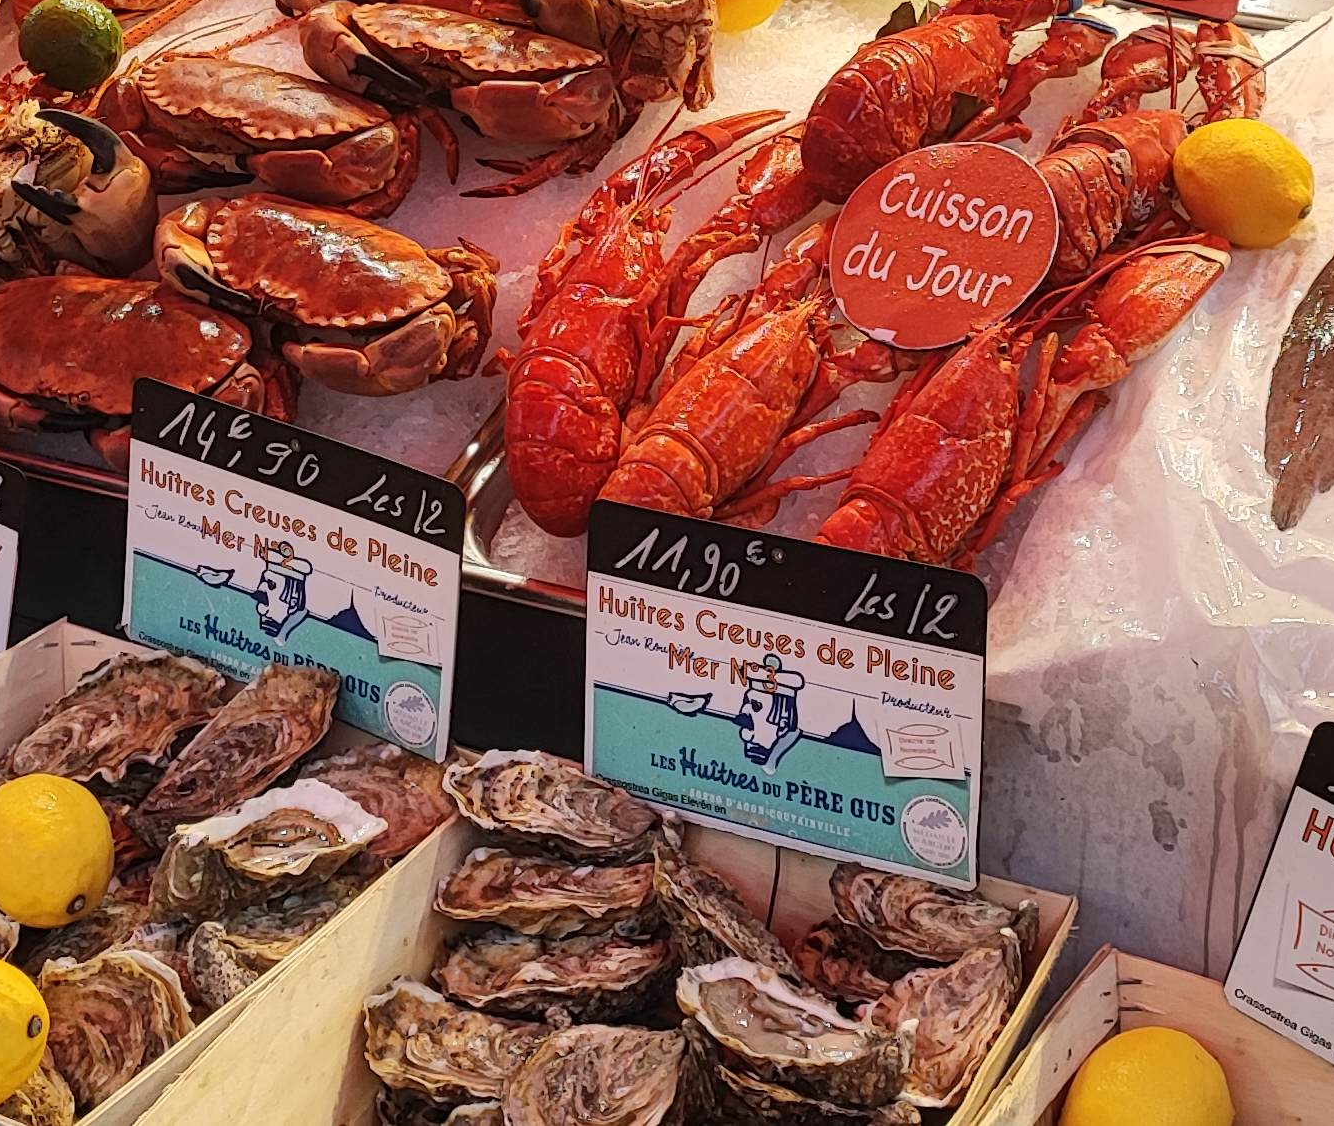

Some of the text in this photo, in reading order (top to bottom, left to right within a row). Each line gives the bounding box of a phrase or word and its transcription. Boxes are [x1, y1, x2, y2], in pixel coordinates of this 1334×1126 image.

[879, 172, 1033, 243] Cuisson
[843, 230, 1012, 307] du Jour
[224, 489, 439, 588] Creuses Pleine
[413, 490, 446, 536] 12
[598, 586, 957, 691] Huîtres Creuses de Pleine
[907, 584, 960, 639] 12
[344, 675, 382, 704] GUS
[668, 642, 720, 680] Mer
[650, 752, 897, 827] LES DU PÈRE GUS
[1233, 987, 1297, 1032] Crassostrea
